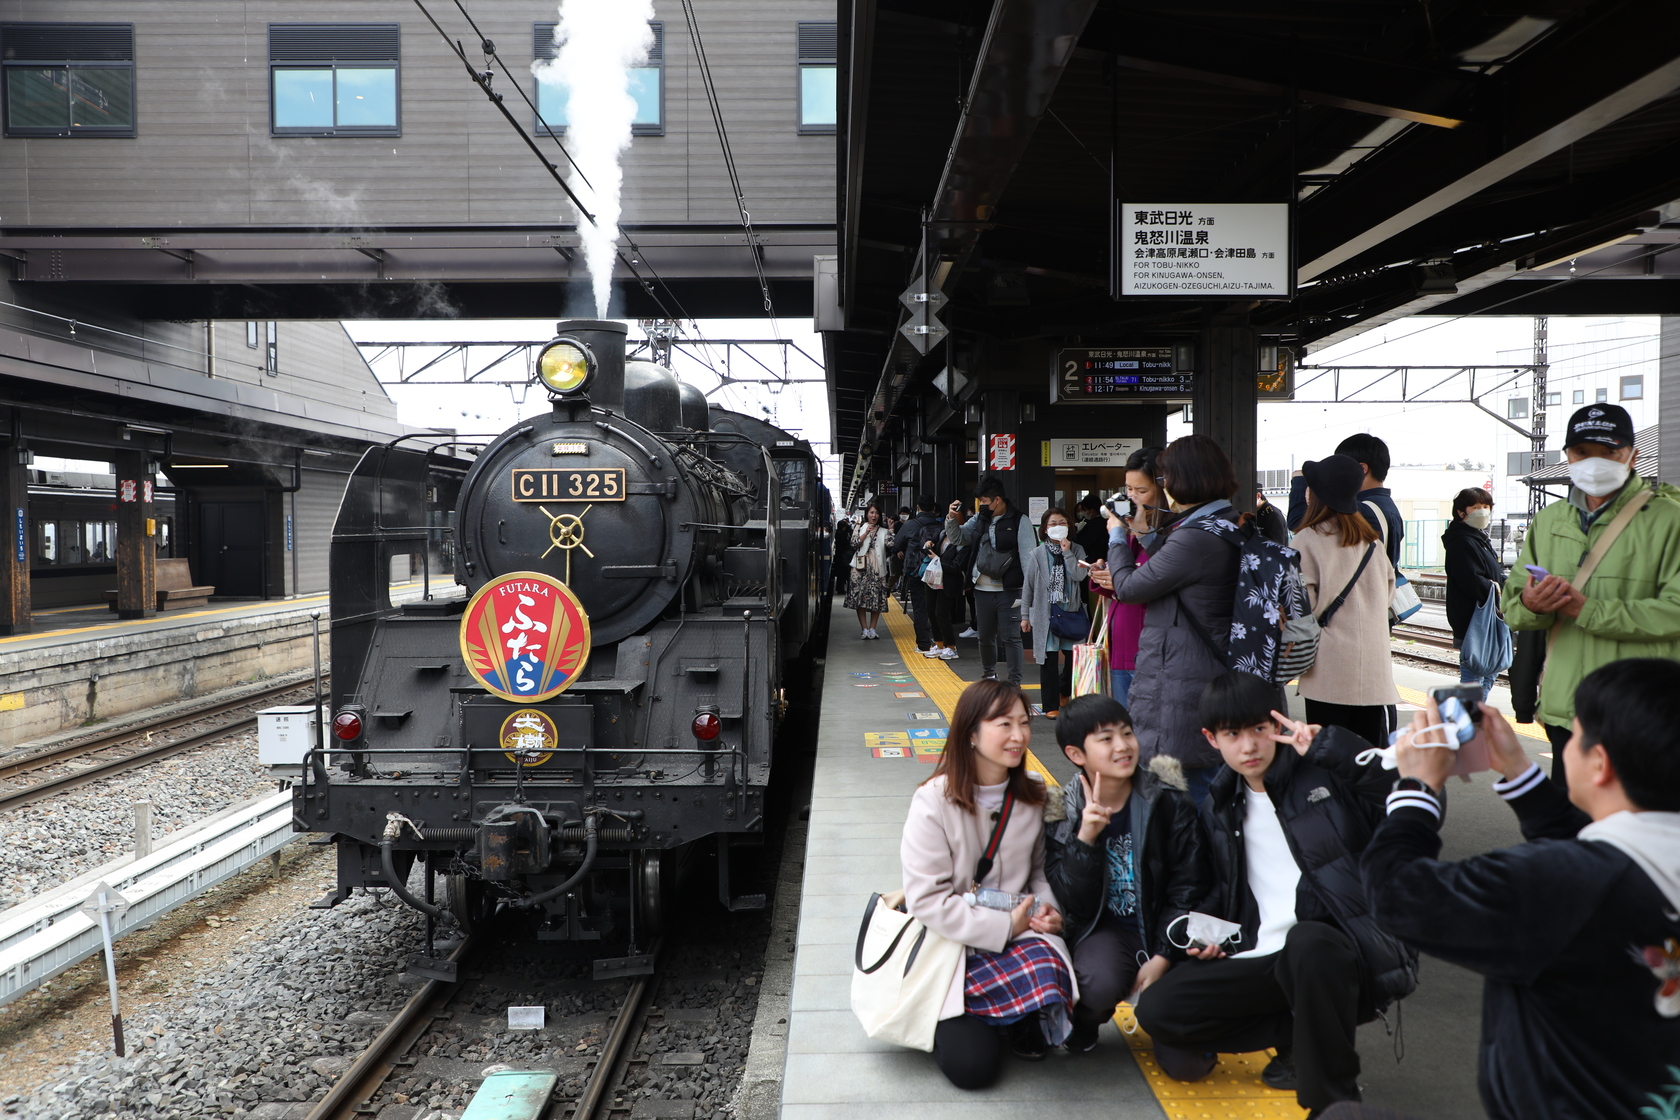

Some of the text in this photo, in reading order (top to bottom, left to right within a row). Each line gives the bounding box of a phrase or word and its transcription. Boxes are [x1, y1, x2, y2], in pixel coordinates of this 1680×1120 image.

[1134, 210, 1215, 226] 東武日光 方面
[1134, 230, 1209, 245] 鬼怒川温泉
[1134, 248, 1256, 258] 会津高原尾瀬口・会津田島
[1064, 360, 1078, 380] 2
[499, 582, 549, 597] FUTARA
[502, 594, 548, 692] ふたら
